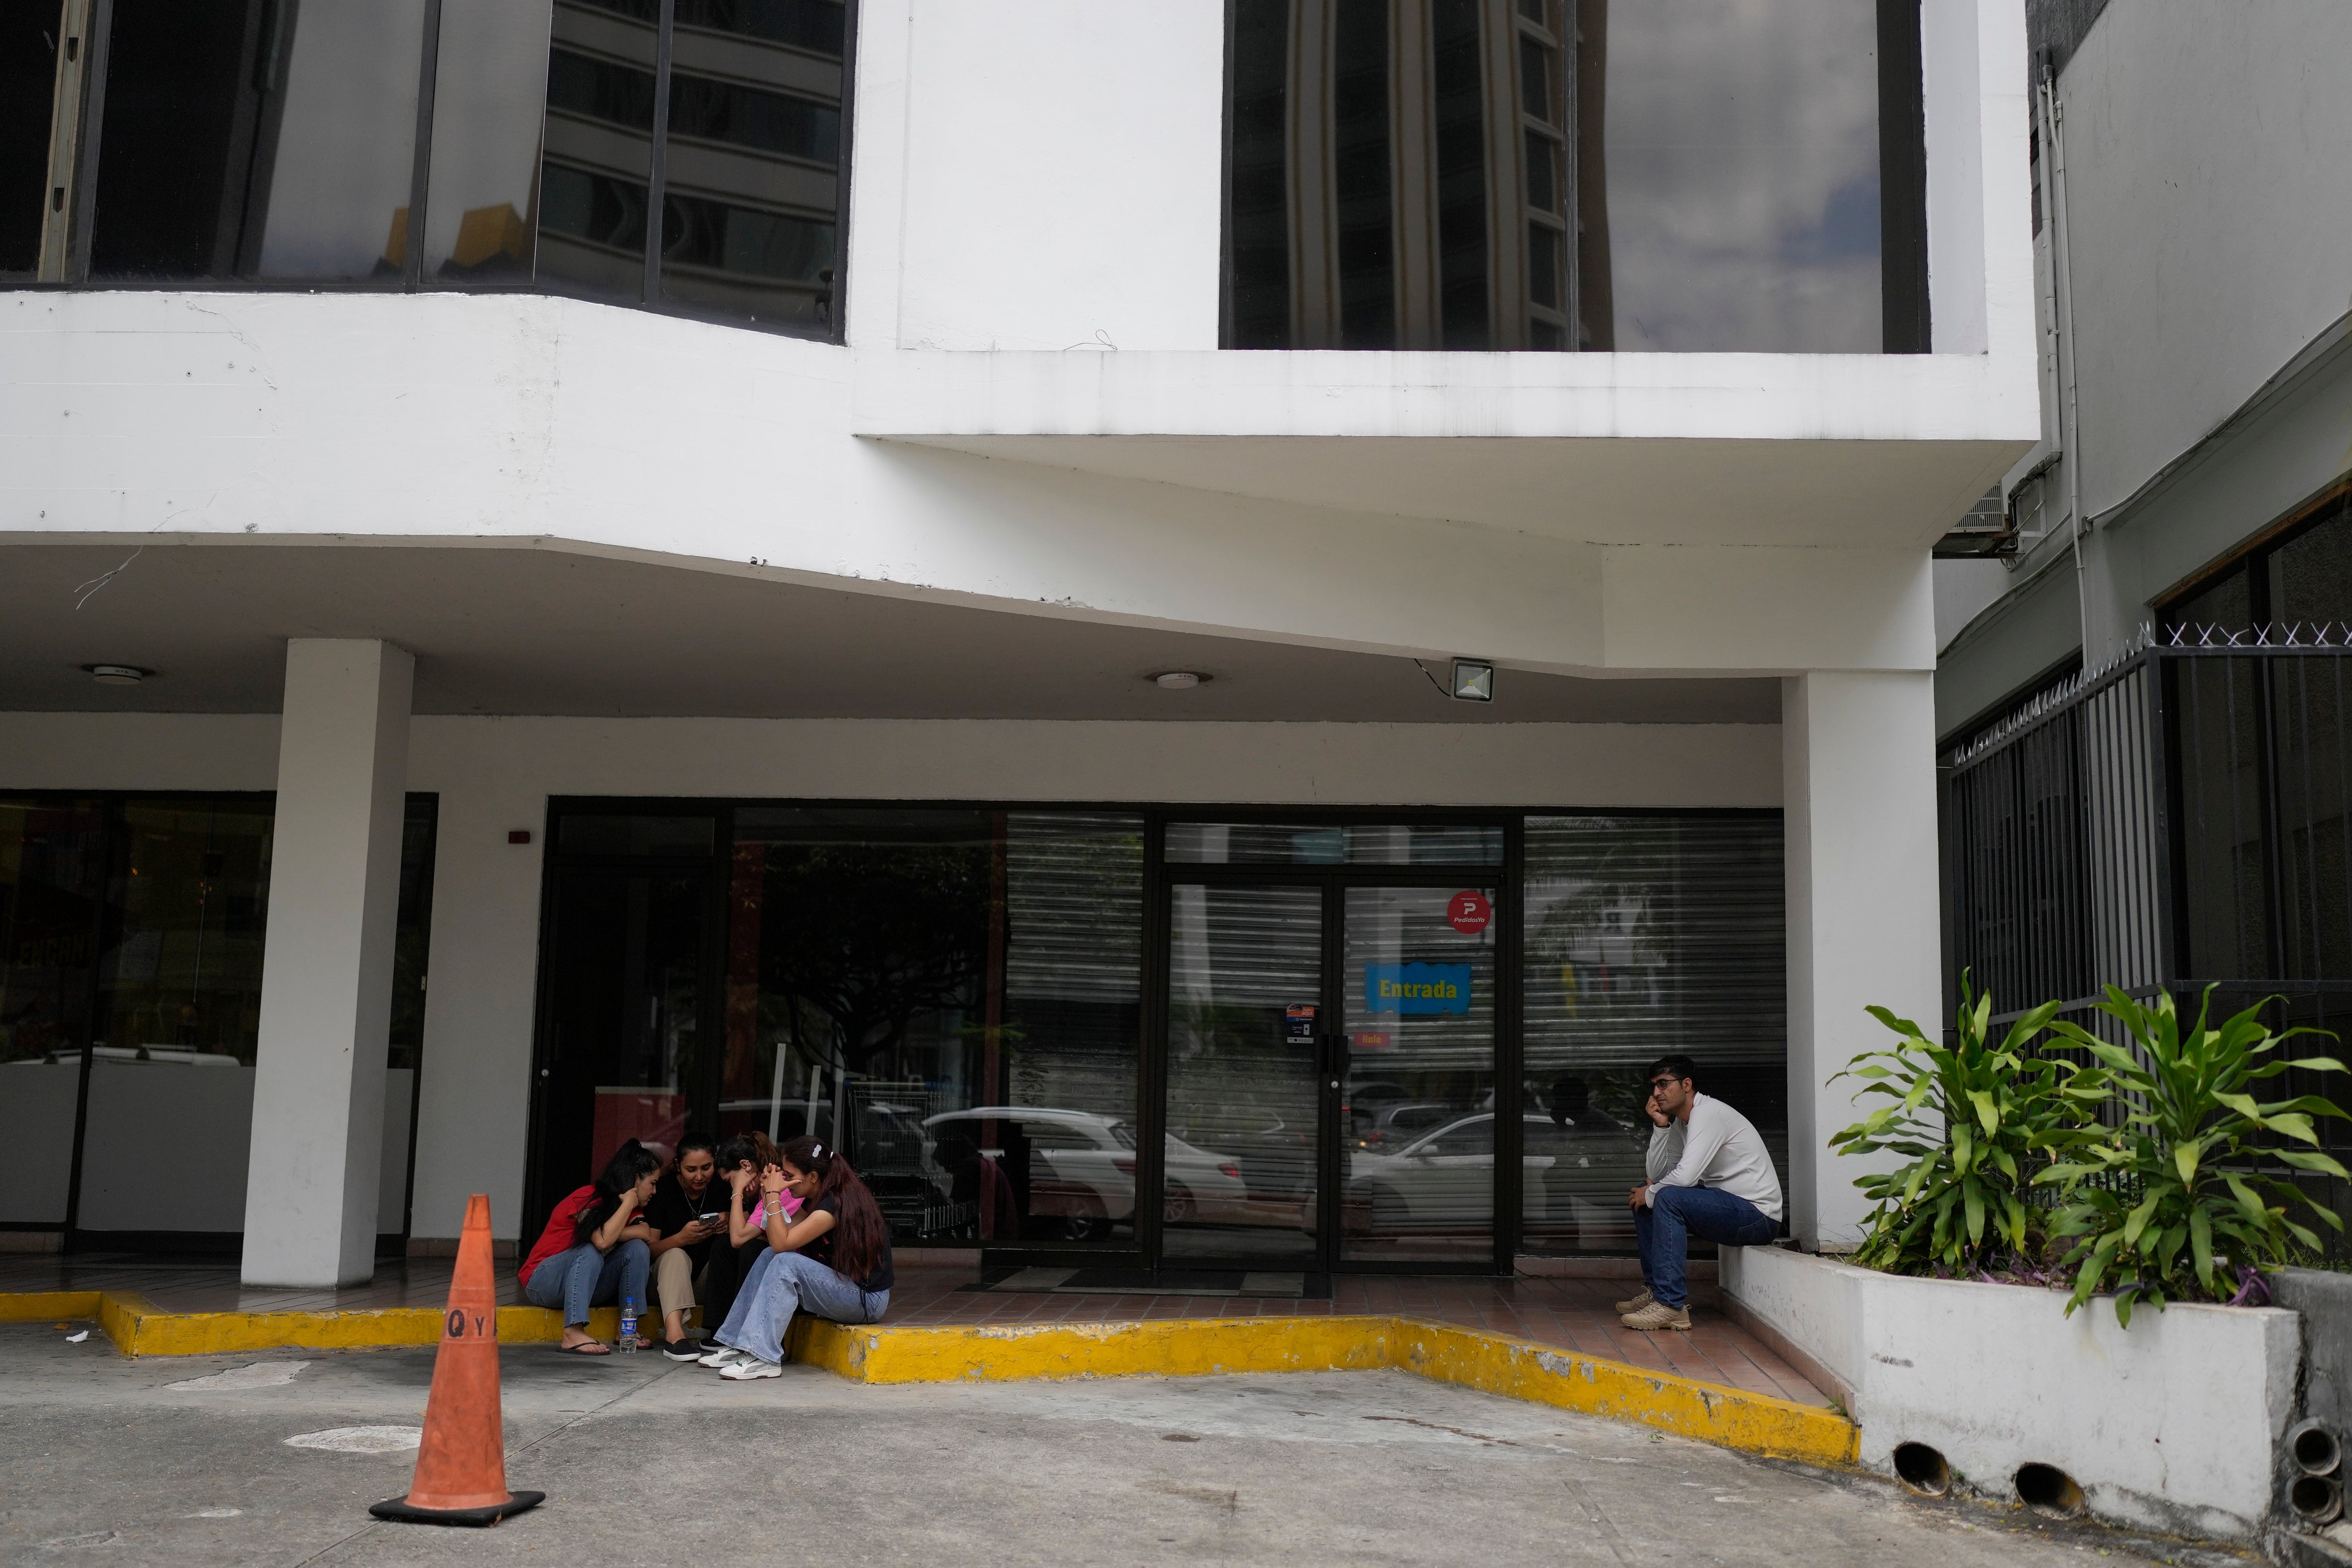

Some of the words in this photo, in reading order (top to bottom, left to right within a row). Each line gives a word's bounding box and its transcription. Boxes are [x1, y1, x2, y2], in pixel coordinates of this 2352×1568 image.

[1380, 980, 1457, 998] Entrada
[1362, 1035, 1381, 1044] Hale
[448, 1310, 464, 1337] Q
